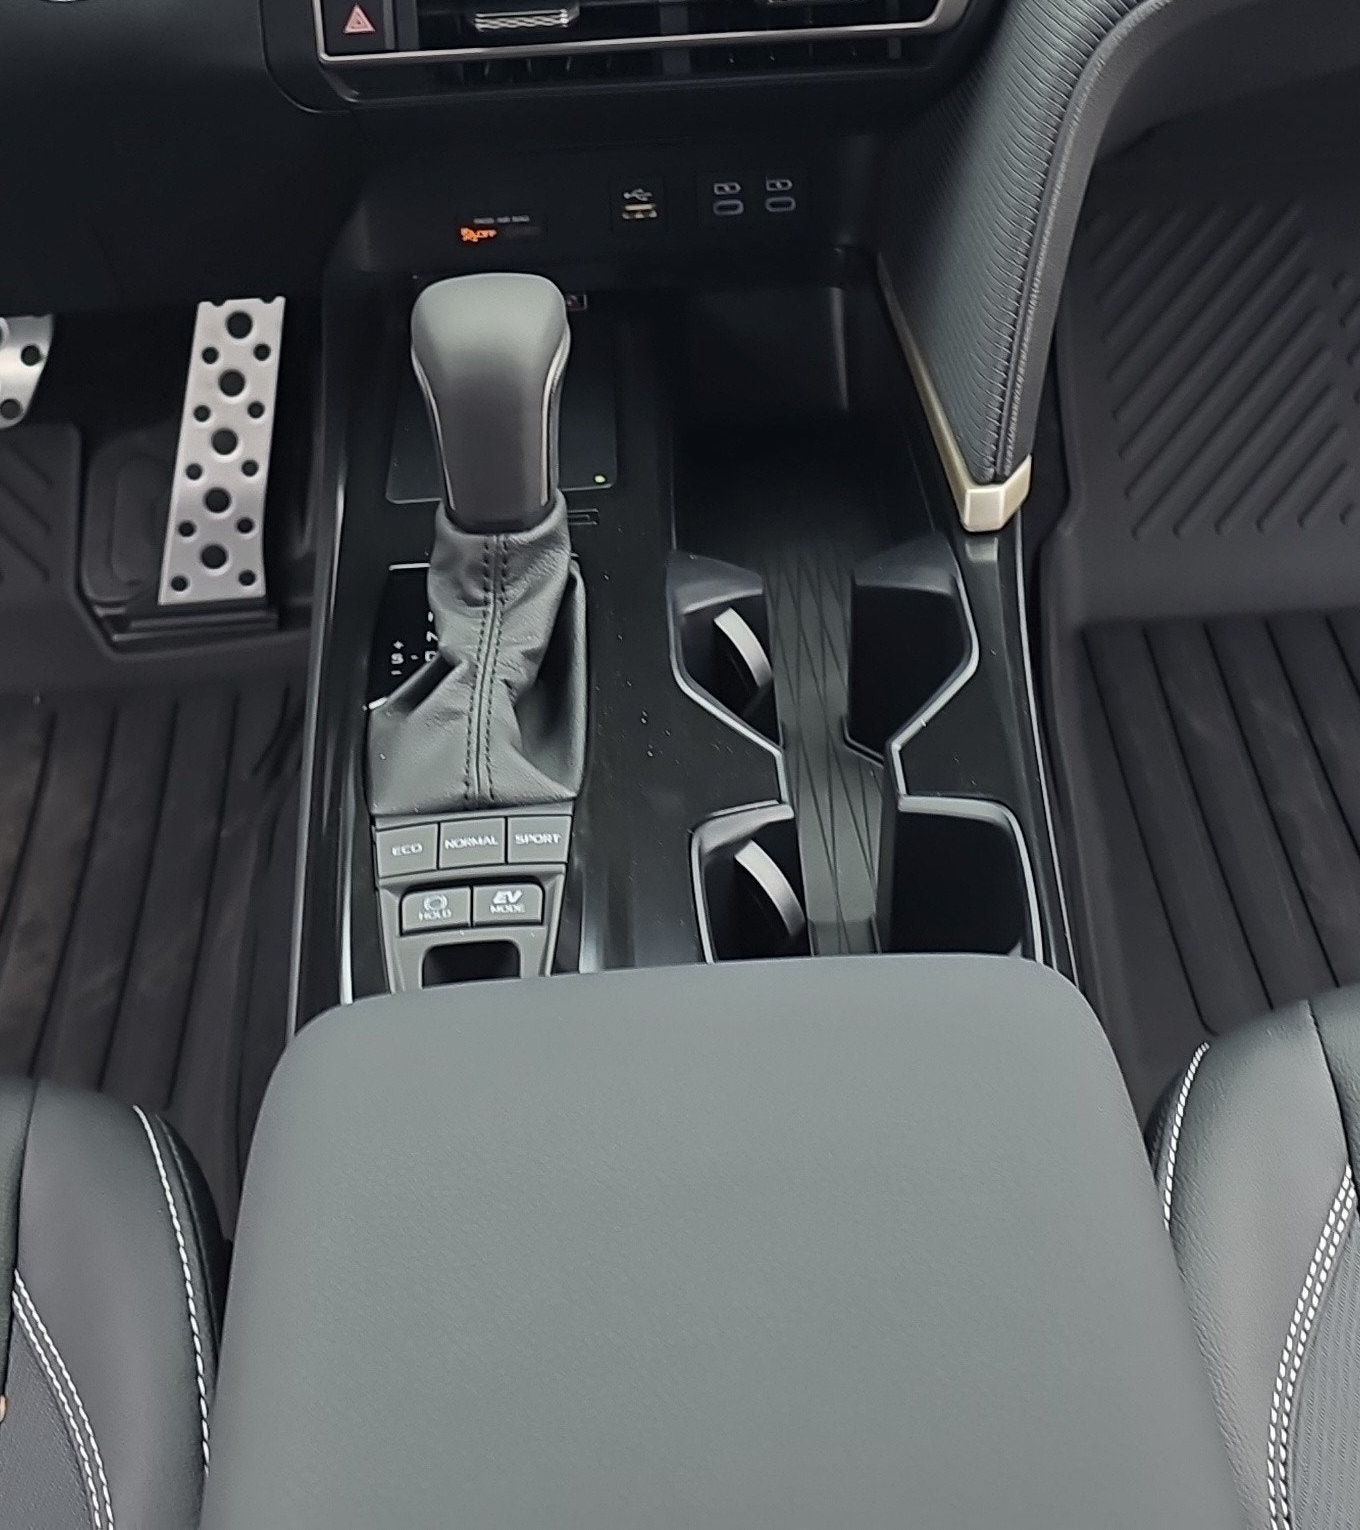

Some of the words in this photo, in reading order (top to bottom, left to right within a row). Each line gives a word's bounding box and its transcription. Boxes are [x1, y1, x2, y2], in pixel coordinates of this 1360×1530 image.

[444, 834, 500, 850] NORMAL
[515, 832, 562, 845] SPORT
[392, 842, 423, 857] ECO
[492, 889, 523, 905] EV
